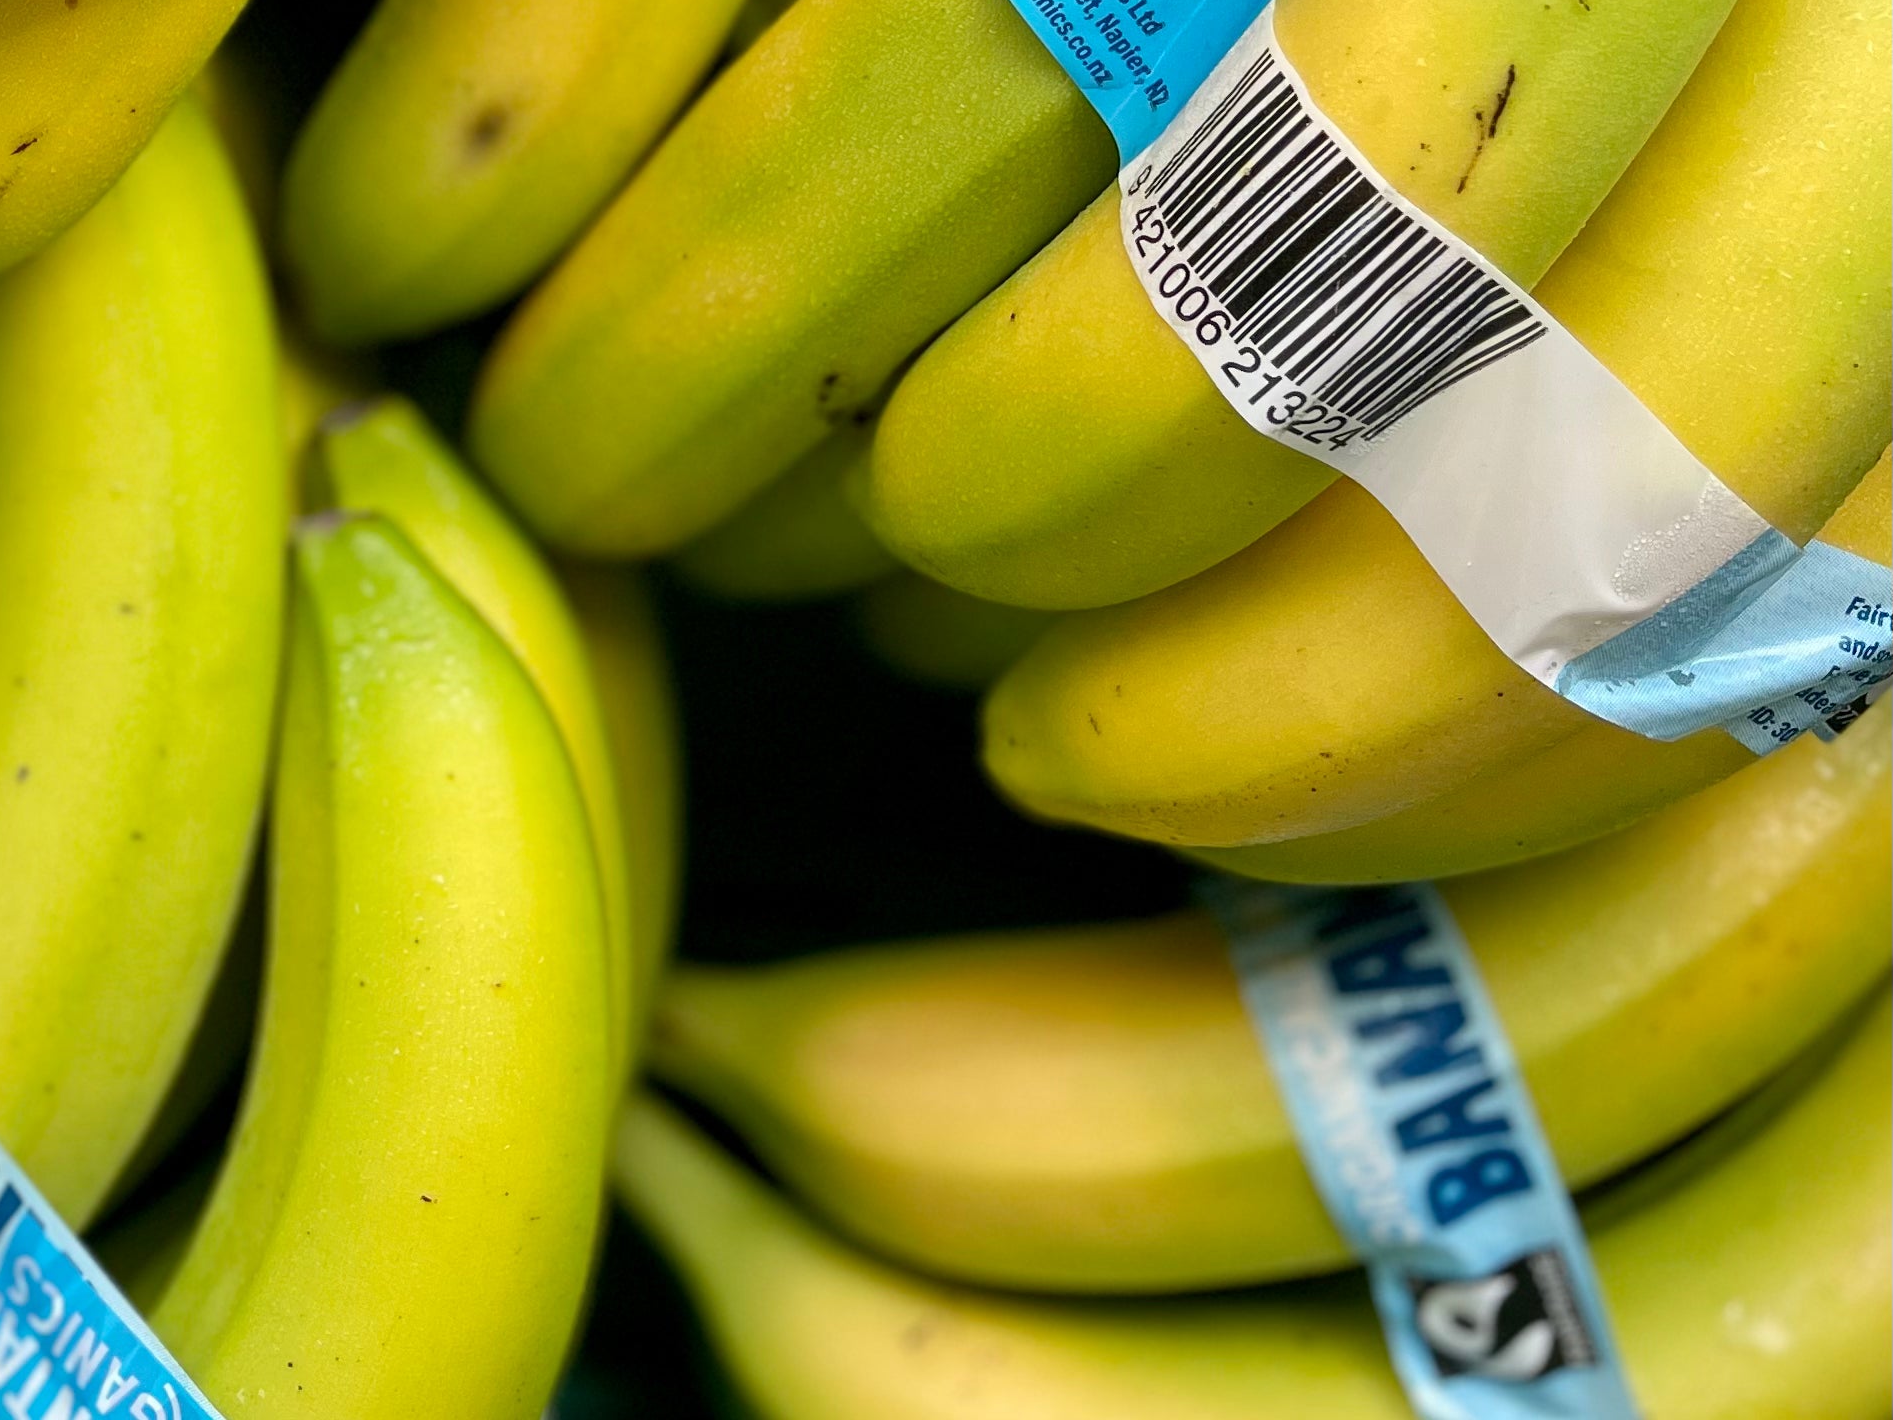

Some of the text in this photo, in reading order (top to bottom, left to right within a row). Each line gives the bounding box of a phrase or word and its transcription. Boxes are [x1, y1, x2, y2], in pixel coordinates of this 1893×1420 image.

[1095, 12, 1153, 85] Napier,
[1144, 77, 1171, 113] NZ
[1131, 205, 1232, 346] 421006
[1220, 346, 1366, 452] 213224
[1845, 596, 1893, 630] Fair
